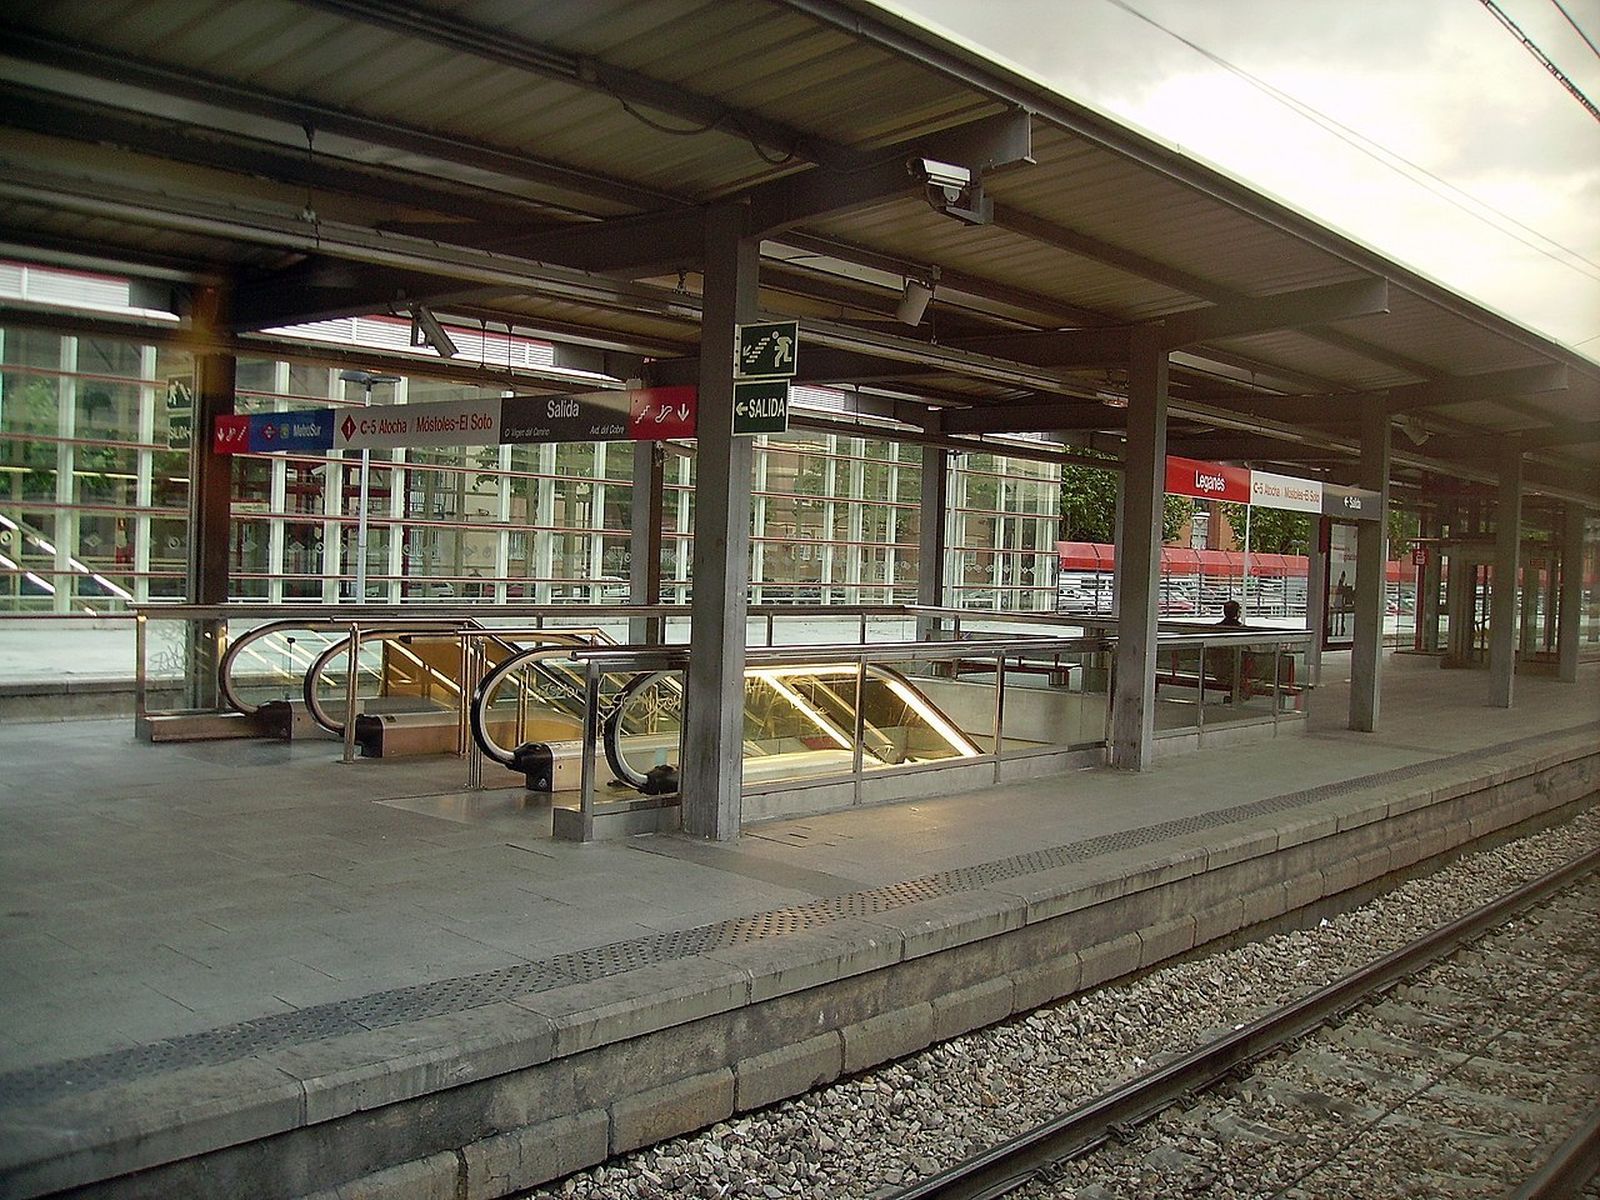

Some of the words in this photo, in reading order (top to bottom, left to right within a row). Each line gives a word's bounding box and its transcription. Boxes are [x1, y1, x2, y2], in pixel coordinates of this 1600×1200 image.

[547, 399, 580, 419] Salida
[748, 398, 785, 418] SALIDA
[293, 423, 321, 438] MetroSur
[360, 420, 377, 435] C-5
[379, 418, 407, 434] Atocha
[471, 412, 493, 430] Soto
[1195, 470, 1226, 493] Leganés
